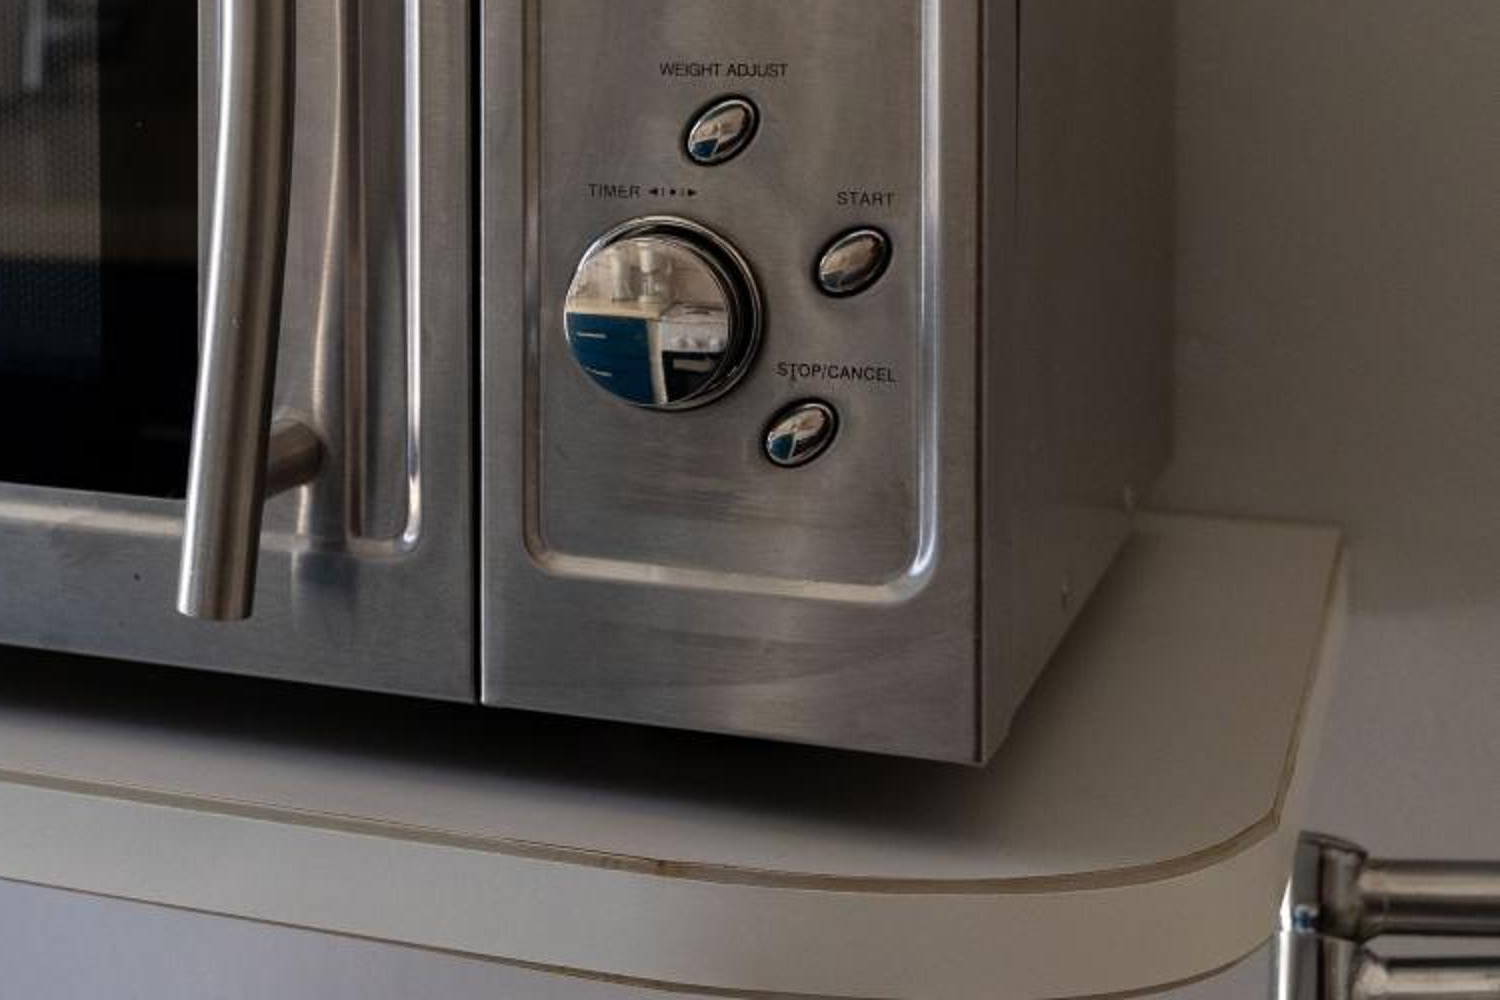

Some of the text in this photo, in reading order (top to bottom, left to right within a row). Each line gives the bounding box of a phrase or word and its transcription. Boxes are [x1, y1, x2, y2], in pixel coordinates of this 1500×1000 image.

[659, 61, 789, 79] WEIGHT ADJUST
[588, 183, 642, 199] TIMER
[836, 191, 895, 207] START
[776, 361, 897, 384] STOP/CANCEL
